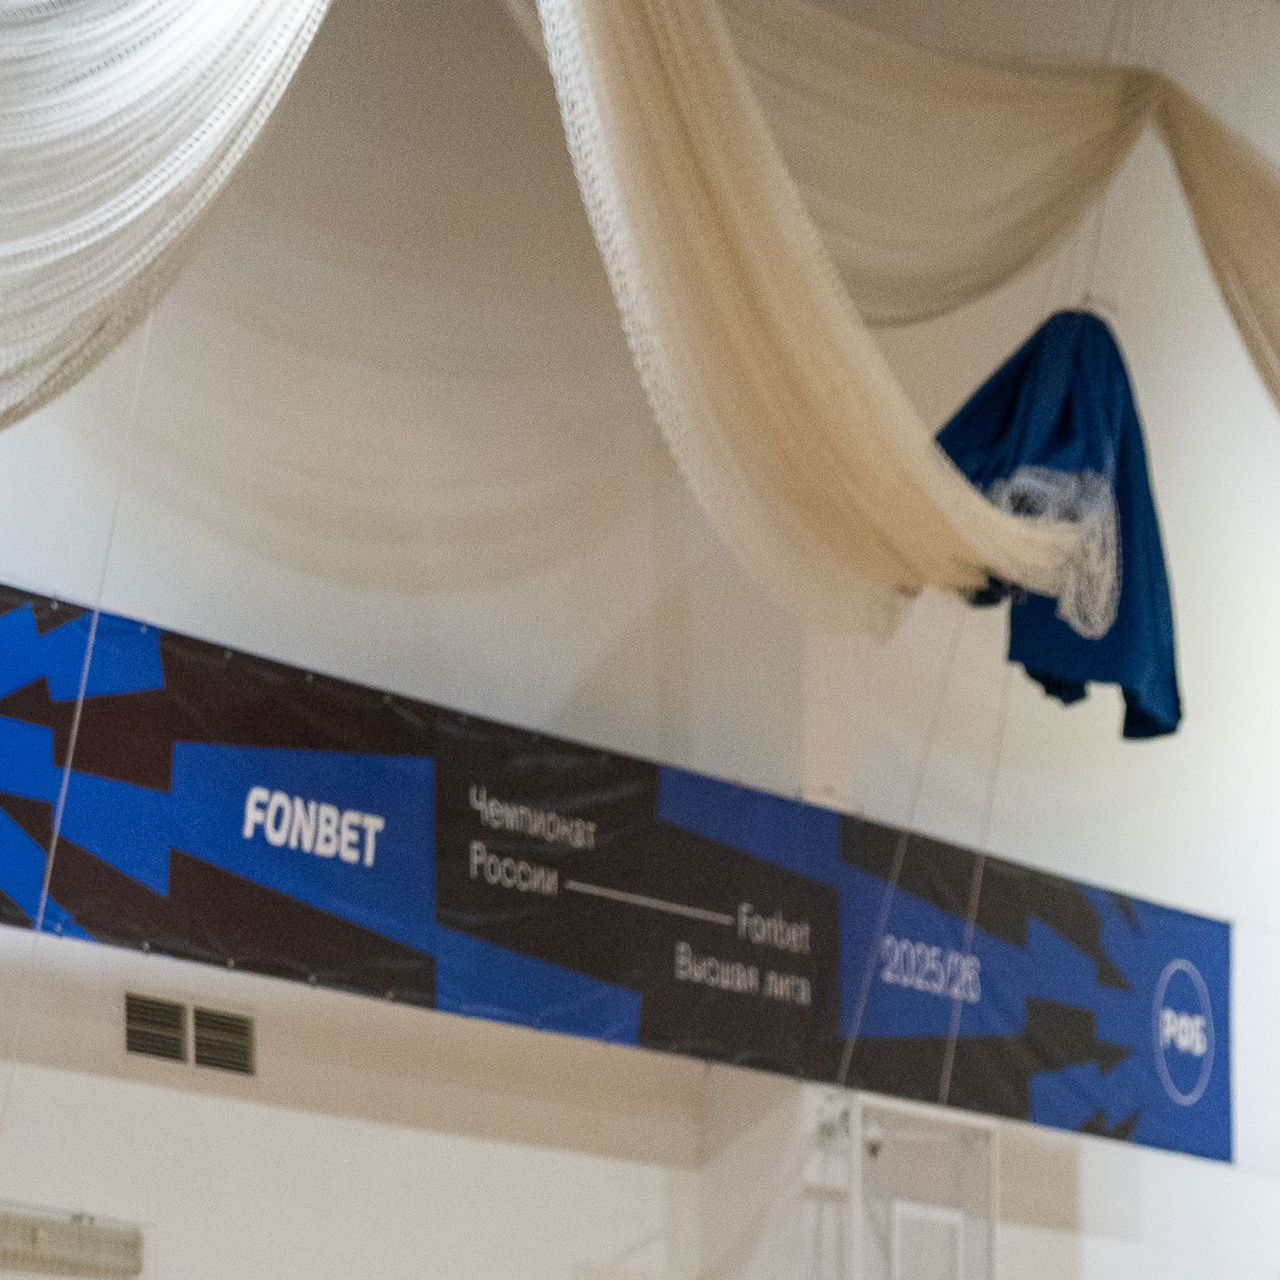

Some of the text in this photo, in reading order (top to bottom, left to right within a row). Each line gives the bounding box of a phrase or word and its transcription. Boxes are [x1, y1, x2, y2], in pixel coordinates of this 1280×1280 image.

[242, 786, 386, 867] FONBET
[468, 784, 597, 850] Чемпионат
[469, 841, 559, 895] России
[737, 902, 811, 954] Fonbet
[880, 934, 981, 1003] 2025/26
